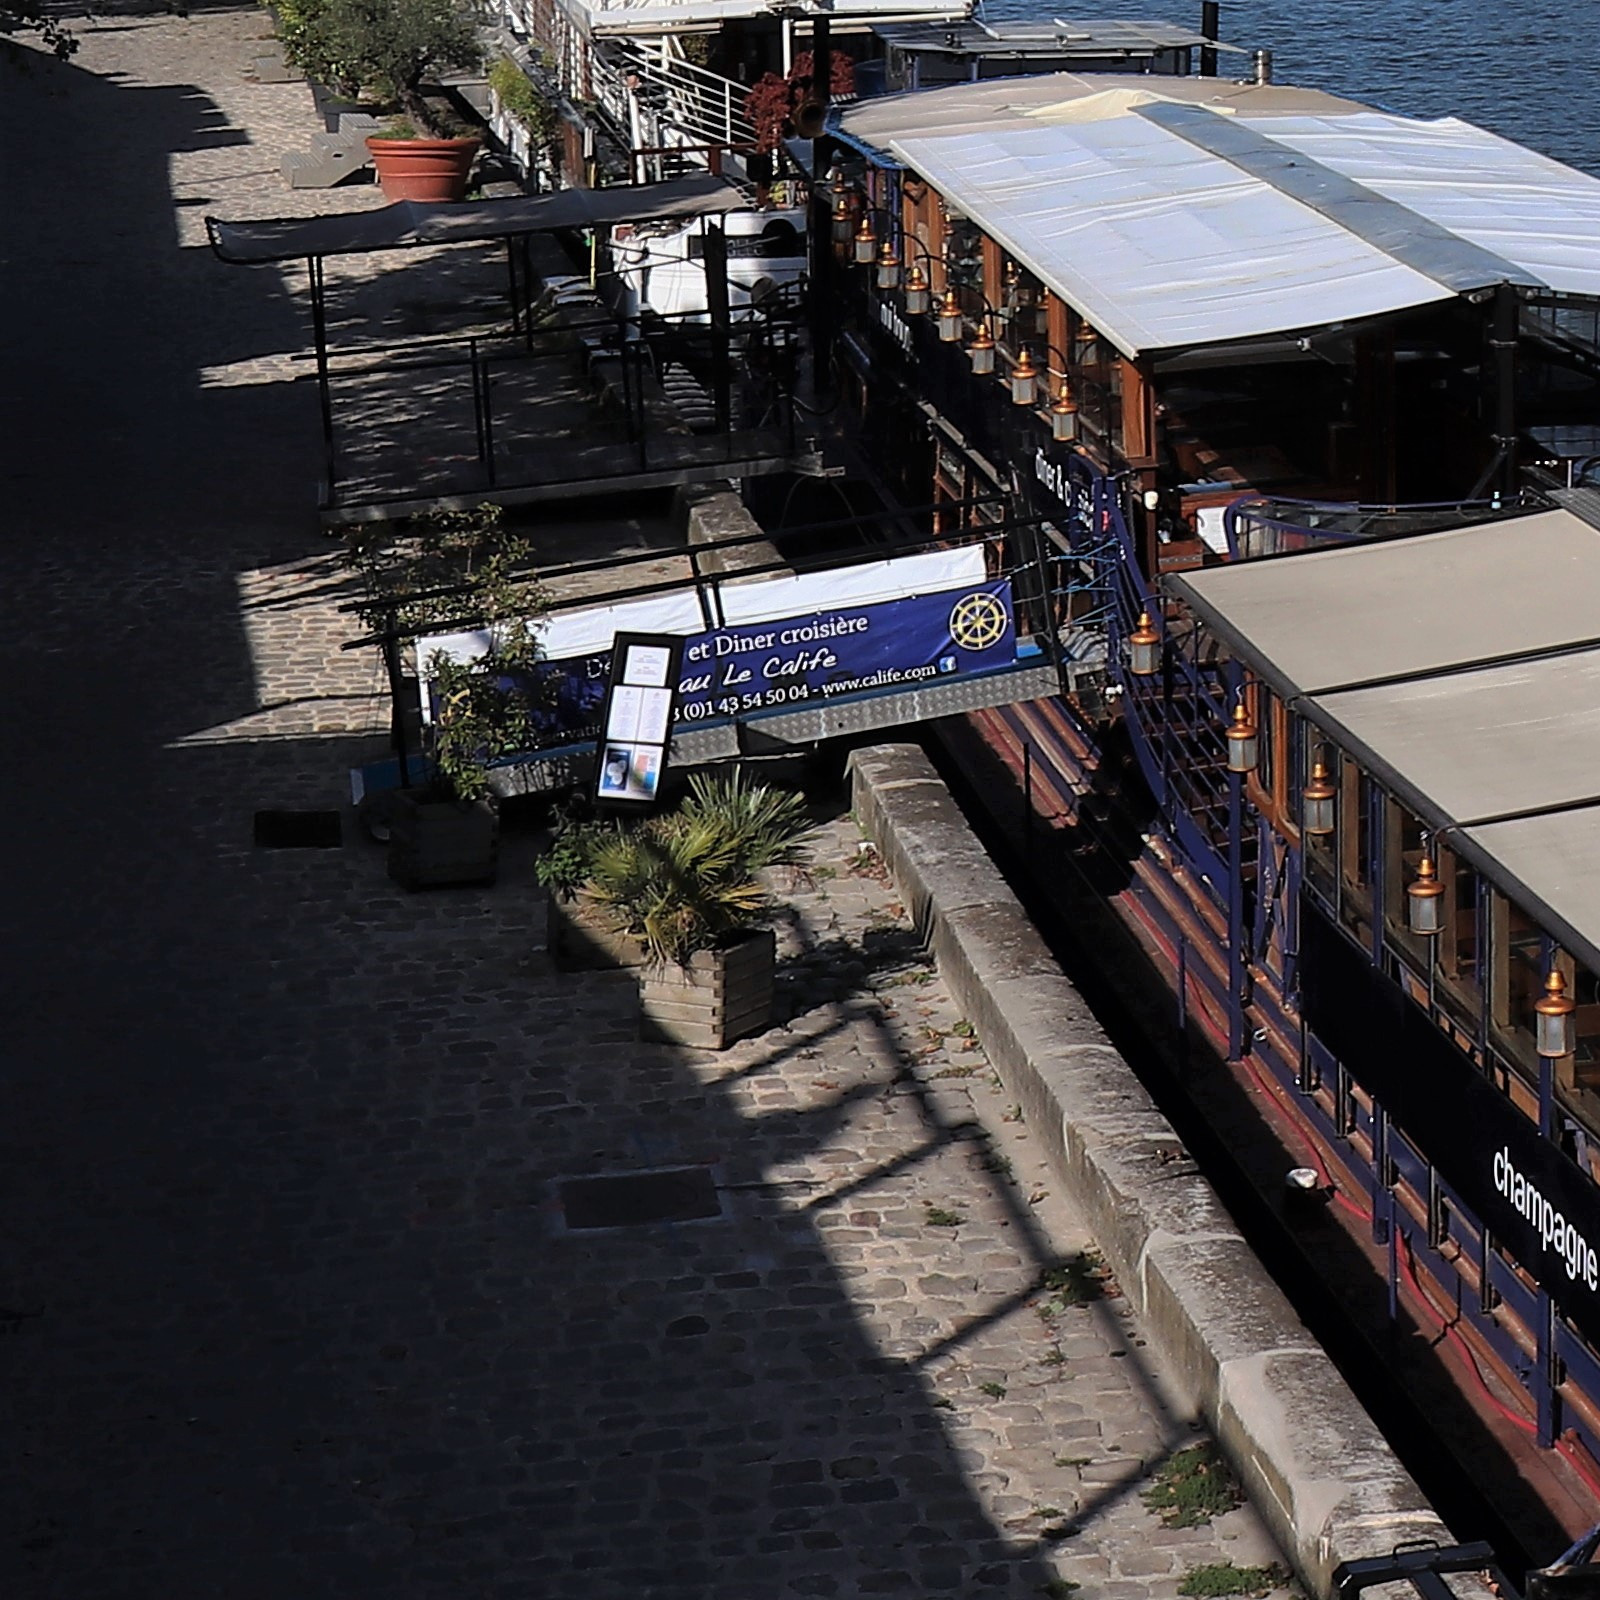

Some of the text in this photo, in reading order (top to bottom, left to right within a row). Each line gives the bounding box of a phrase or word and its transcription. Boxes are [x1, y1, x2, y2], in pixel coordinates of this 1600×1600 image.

[688, 641, 710, 661] et
[780, 615, 869, 643] croisière
[679, 648, 837, 694] au Le Calife
[684, 701, 715, 721] (0)1
[718, 697, 739, 713] 43
[742, 694, 763, 709] 54
[766, 688, 786, 704] 50
[789, 684, 809, 700] 04
[822, 664, 937, 695] www.calife.com
[1494, 1146, 1598, 1292] champagne
